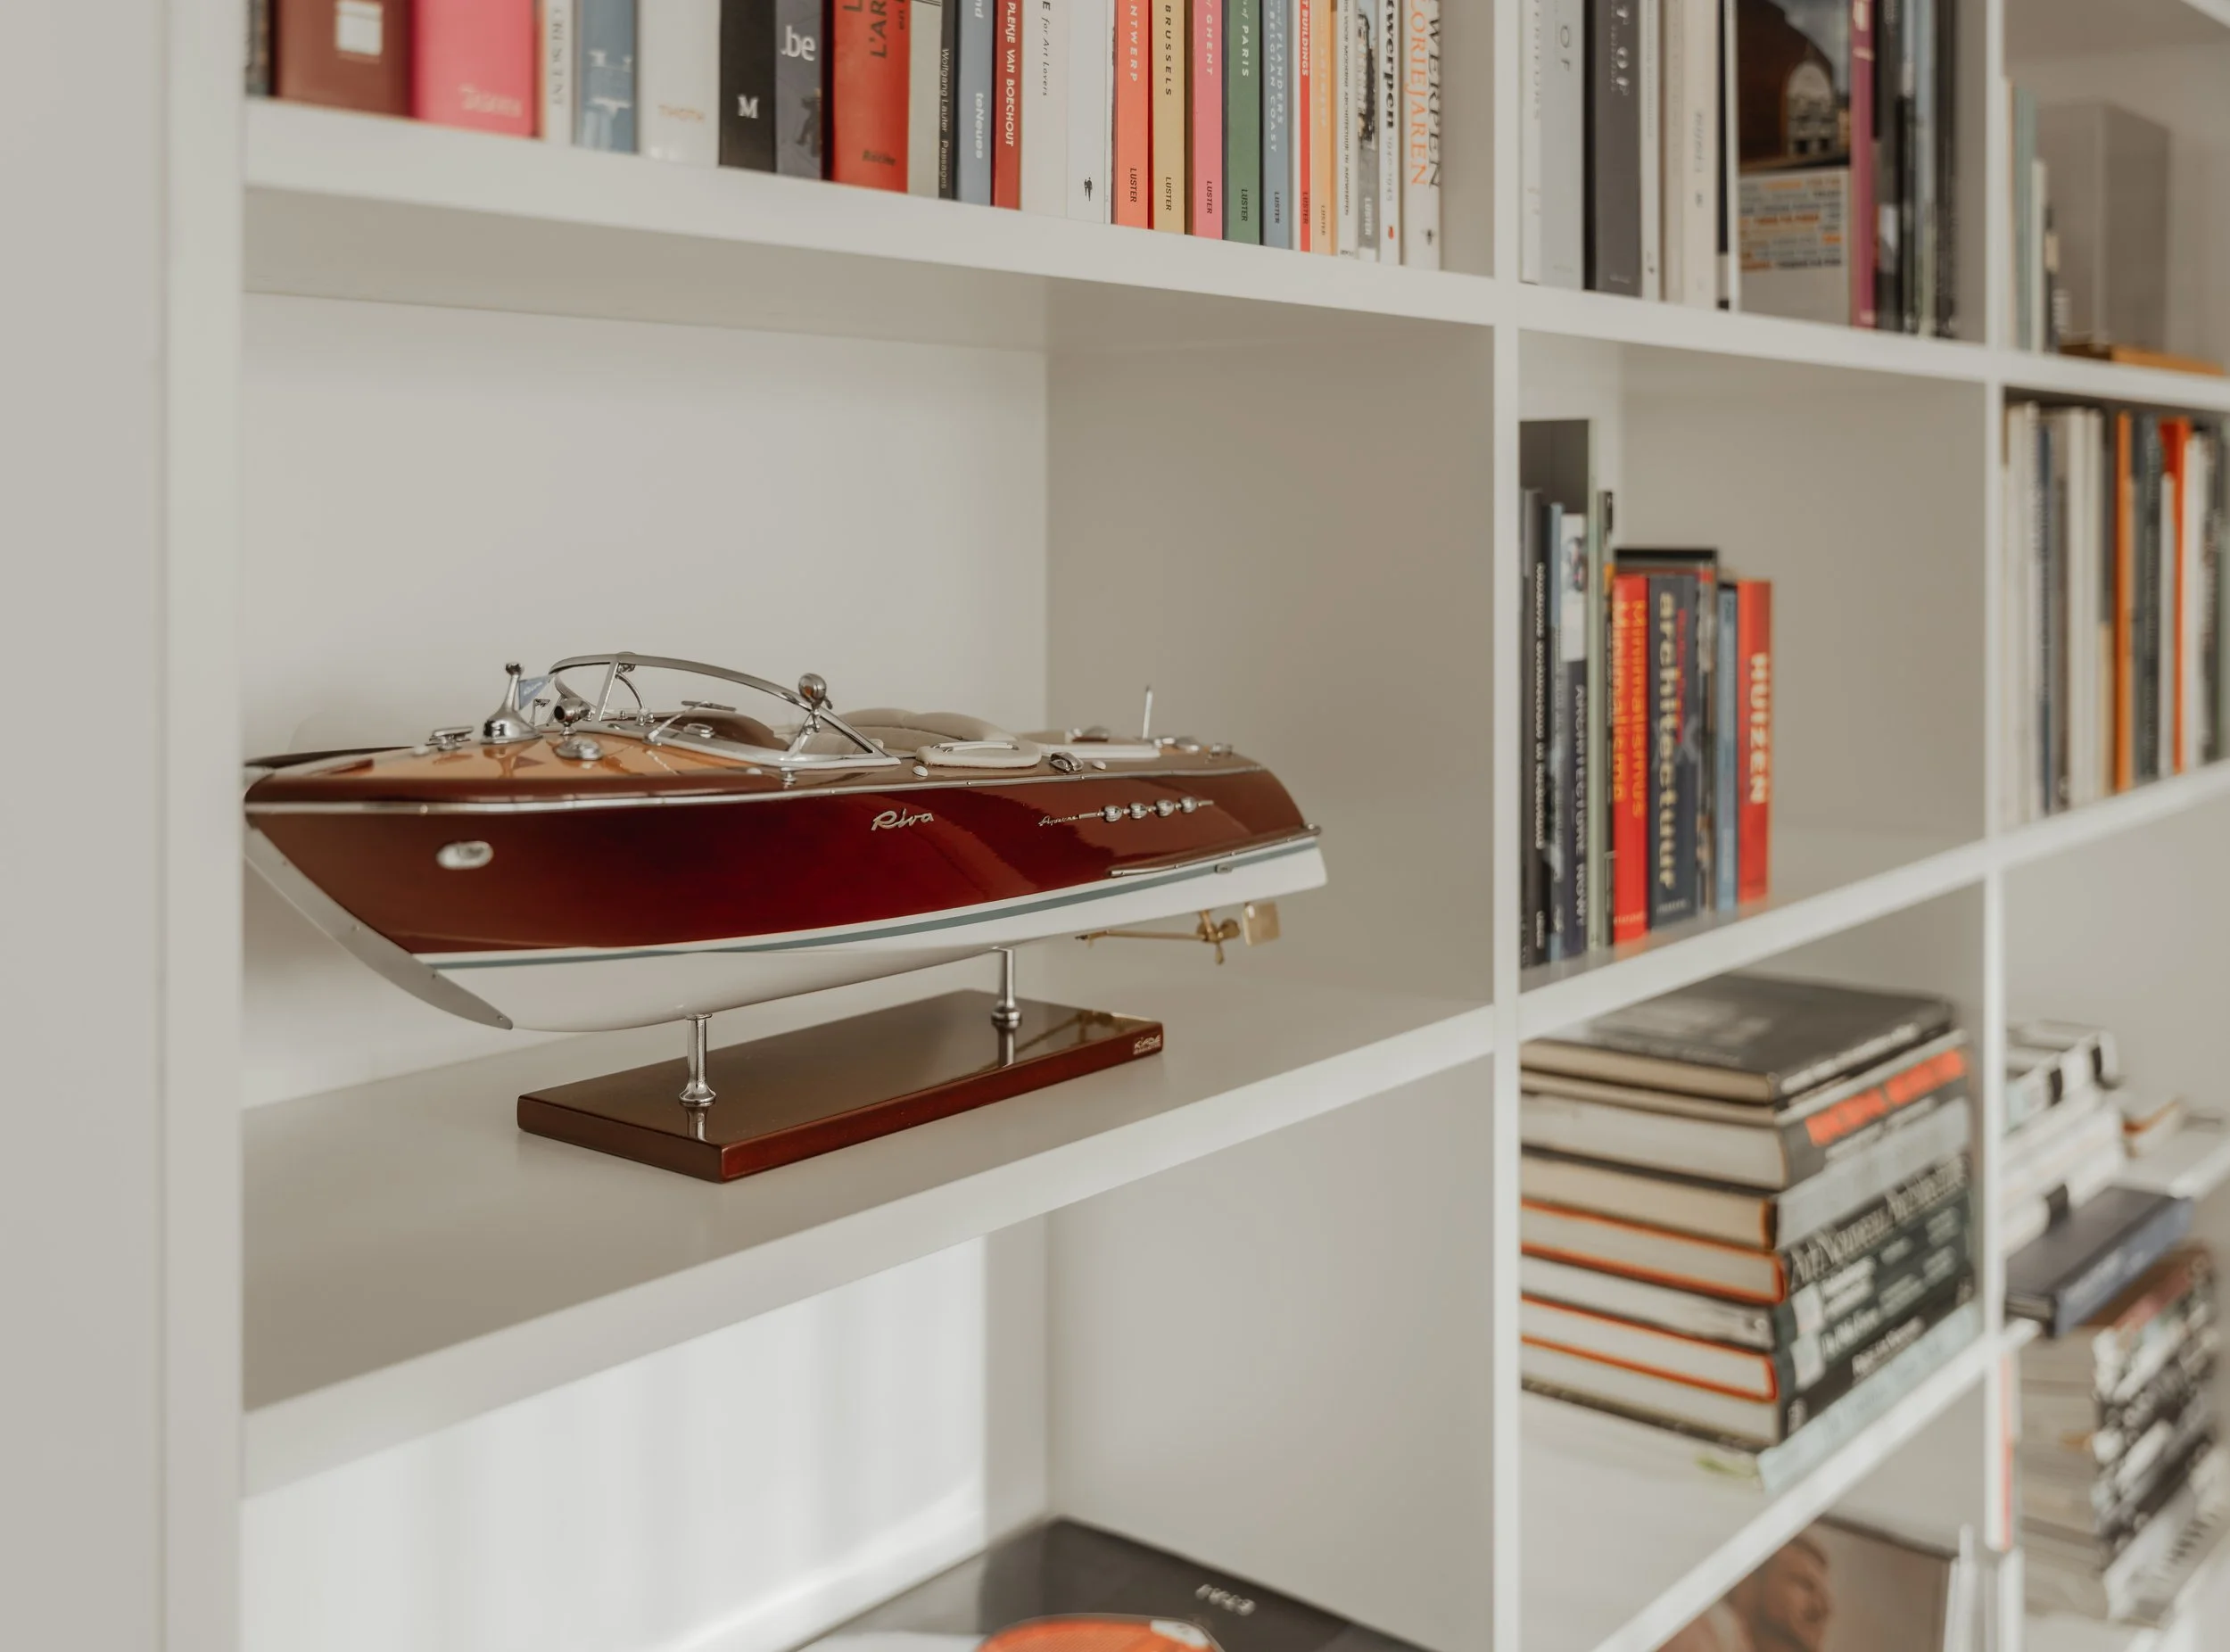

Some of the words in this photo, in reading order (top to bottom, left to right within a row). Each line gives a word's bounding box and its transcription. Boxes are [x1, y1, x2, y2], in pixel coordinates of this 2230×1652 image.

[780, 25, 816, 62] .be
[1006, 2, 1016, 44] PLEKJE
[1041, 16, 1050, 35] for
[1129, 0, 1138, 82] NTWERP
[1301, 9, 1309, 77] BUILDINGS
[1005, 49, 1015, 73] VAN
[1042, 37, 1050, 57] Art
[1242, 25, 1250, 77] PARIS
[940, 48, 950, 97] Wolfgang
[1042, 62, 1050, 96] Lovers
[737, 94, 759, 119] M
[1005, 78, 1015, 147] BOECHOUT
[1428, 0, 1441, 188] WERPEN
[940, 99, 950, 133] Lauter
[1129, 168, 1137, 203] LUSTER
[1241, 188, 1249, 223] LUSTER
[1631, 599, 1648, 819] Minimalismus
[1749, 652, 1768, 805] HUIZEN
[1659, 591, 1681, 891] architectuur
[1575, 683, 1587, 857] ARCHITECTURE
[871, 807, 935, 831] Riva
